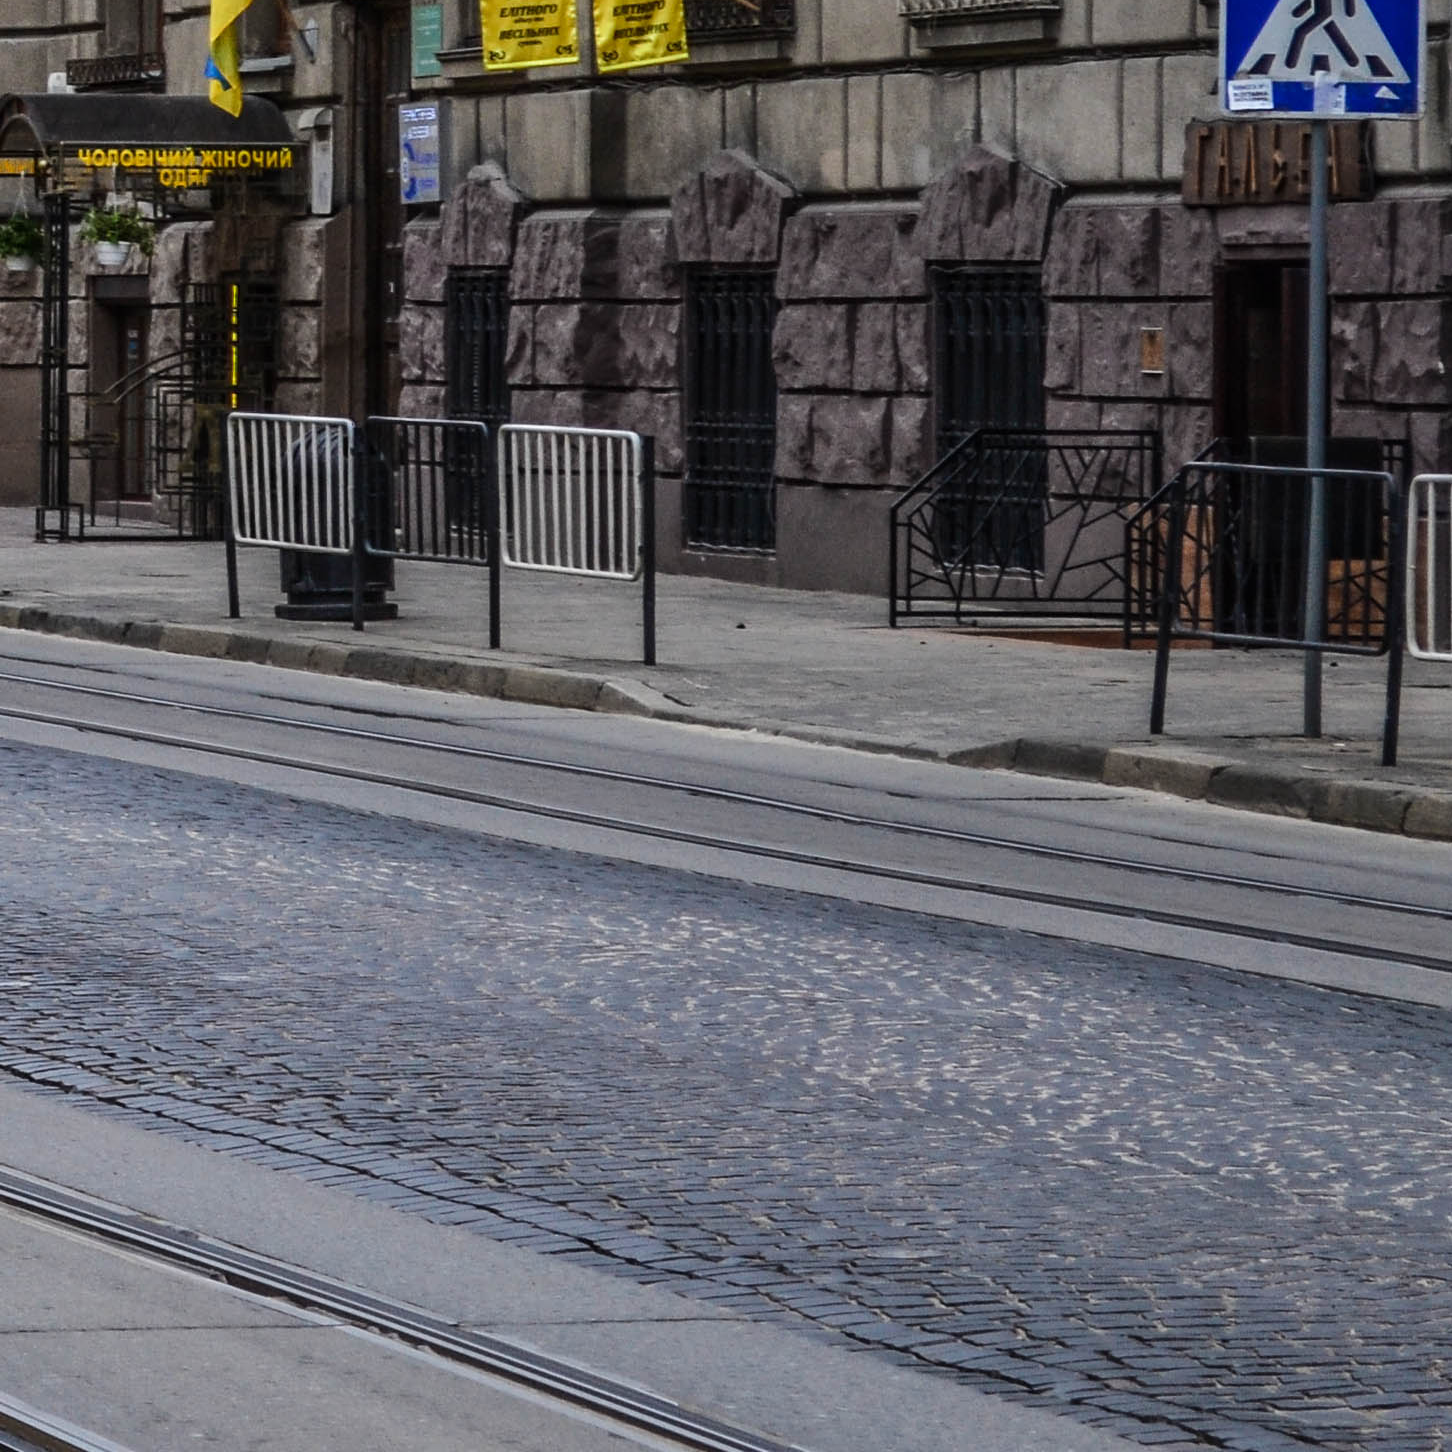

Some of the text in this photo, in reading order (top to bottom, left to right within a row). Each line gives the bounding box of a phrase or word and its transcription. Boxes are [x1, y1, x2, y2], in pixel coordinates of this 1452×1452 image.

[77, 147, 293, 169] ЧОЛОВІЧИЙ ЖІНОЧИЙ
[158, 168, 214, 189] ОДЯГ
